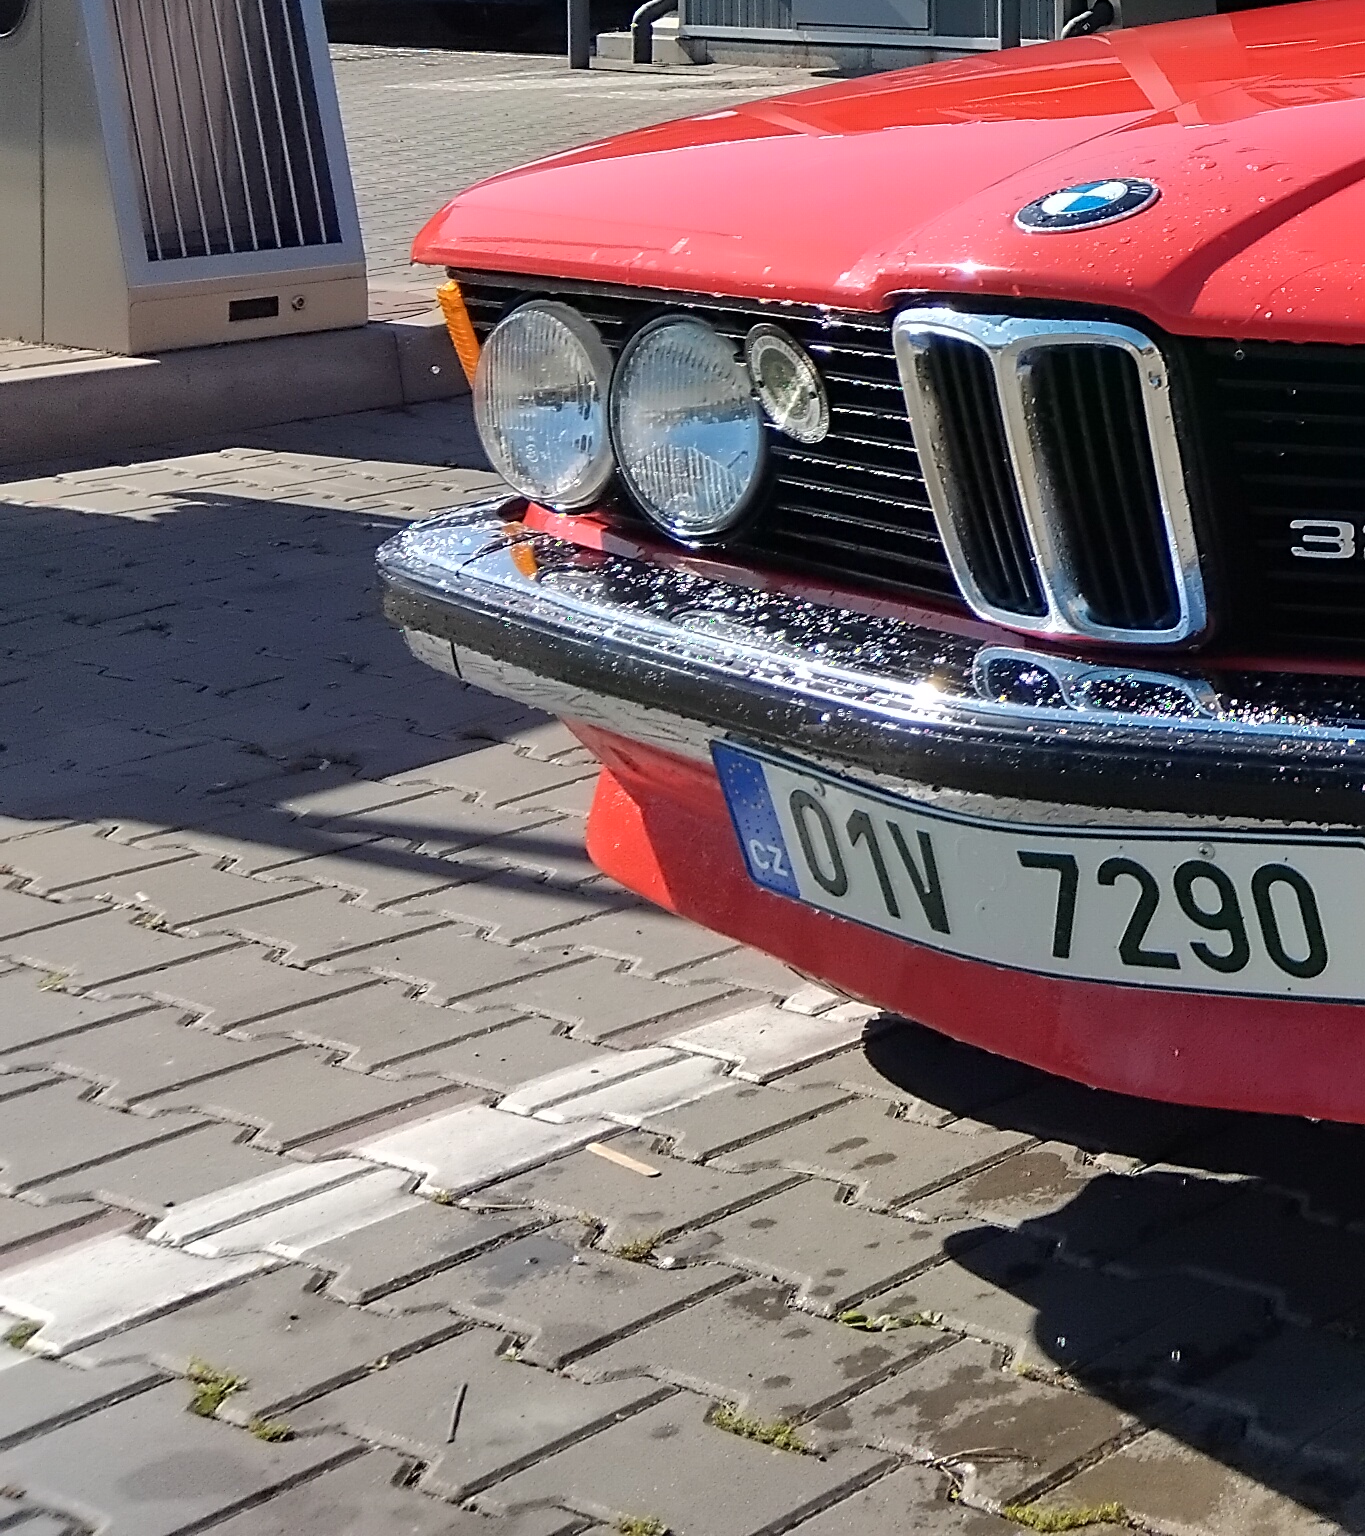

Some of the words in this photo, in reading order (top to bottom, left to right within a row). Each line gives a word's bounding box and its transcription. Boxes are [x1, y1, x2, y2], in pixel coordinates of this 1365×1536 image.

[750, 839, 788, 877] CZ
[789, 788, 950, 934] 01V
[1017, 851, 1328, 980] 7290
